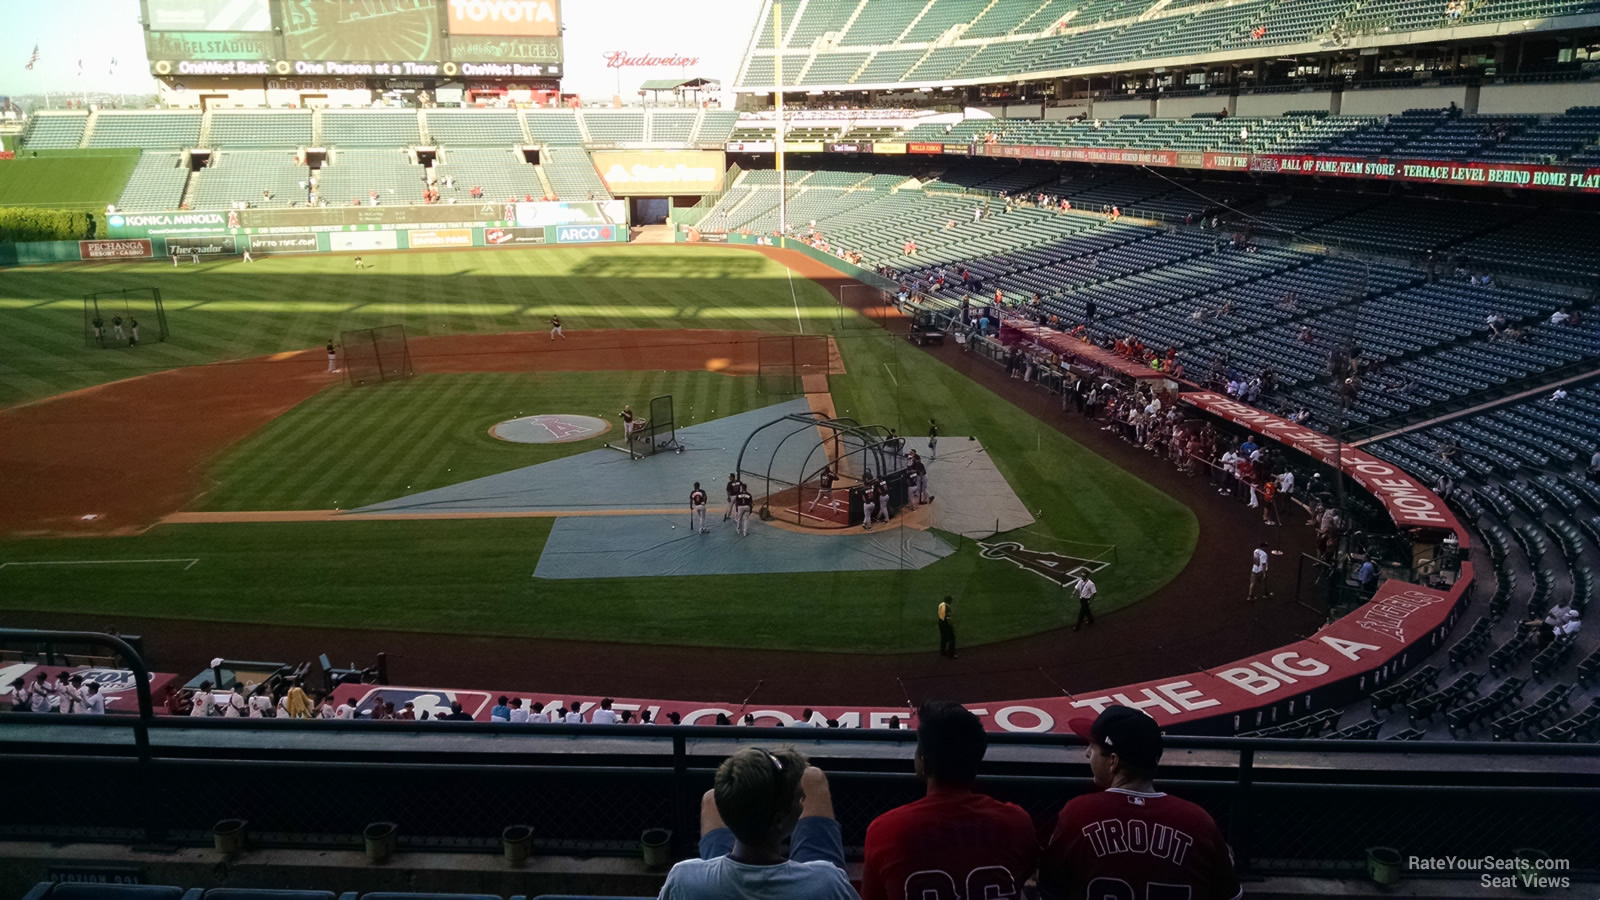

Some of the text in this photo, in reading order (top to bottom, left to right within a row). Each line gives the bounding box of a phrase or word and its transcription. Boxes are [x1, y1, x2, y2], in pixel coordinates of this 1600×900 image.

[451, 0, 555, 22] TOYOTA
[162, 38, 265, 54] ANGEL STADIUM
[512, 39, 558, 58] ANGELS
[179, 61, 270, 75] OneWest Bank
[295, 61, 324, 75] One
[326, 61, 372, 75] Person
[375, 62, 390, 75] at
[392, 64, 401, 75] a
[602, 50, 699, 69] Budweiser
[462, 63, 542, 76] OneWest Bank
[1214, 155, 1232, 167] VISIT
[1233, 156, 1247, 168] THE
[1250, 154, 1278, 172] ANGELS
[1281, 158, 1301, 171] HALL
[1303, 160, 1315, 171] OF
[1315, 160, 1338, 173] FAME
[1339, 161, 1363, 174] TEAM
[1365, 163, 1395, 176] STORE
[1403, 164, 1449, 179] TERRACE
[1451, 167, 1485, 181] LEVEL
[1488, 169, 1531, 184] BEHIND
[1533, 171, 1566, 186] HOME
[126, 213, 224, 227] KONICA MINOLTA
[560, 228, 599, 240] ARCO
[88, 241, 144, 251] PECHANGA
[1193, 394, 1299, 430] ANGELS
[1283, 431, 1351, 454] THE
[1340, 456, 1394, 476] OF
[1371, 478, 1446, 522] HOME
[1216, 652, 1330, 696] BIG
[1319, 635, 1382, 661] A
[83, 671, 134, 683] FOX
[1082, 818, 1193, 866] TROUT
